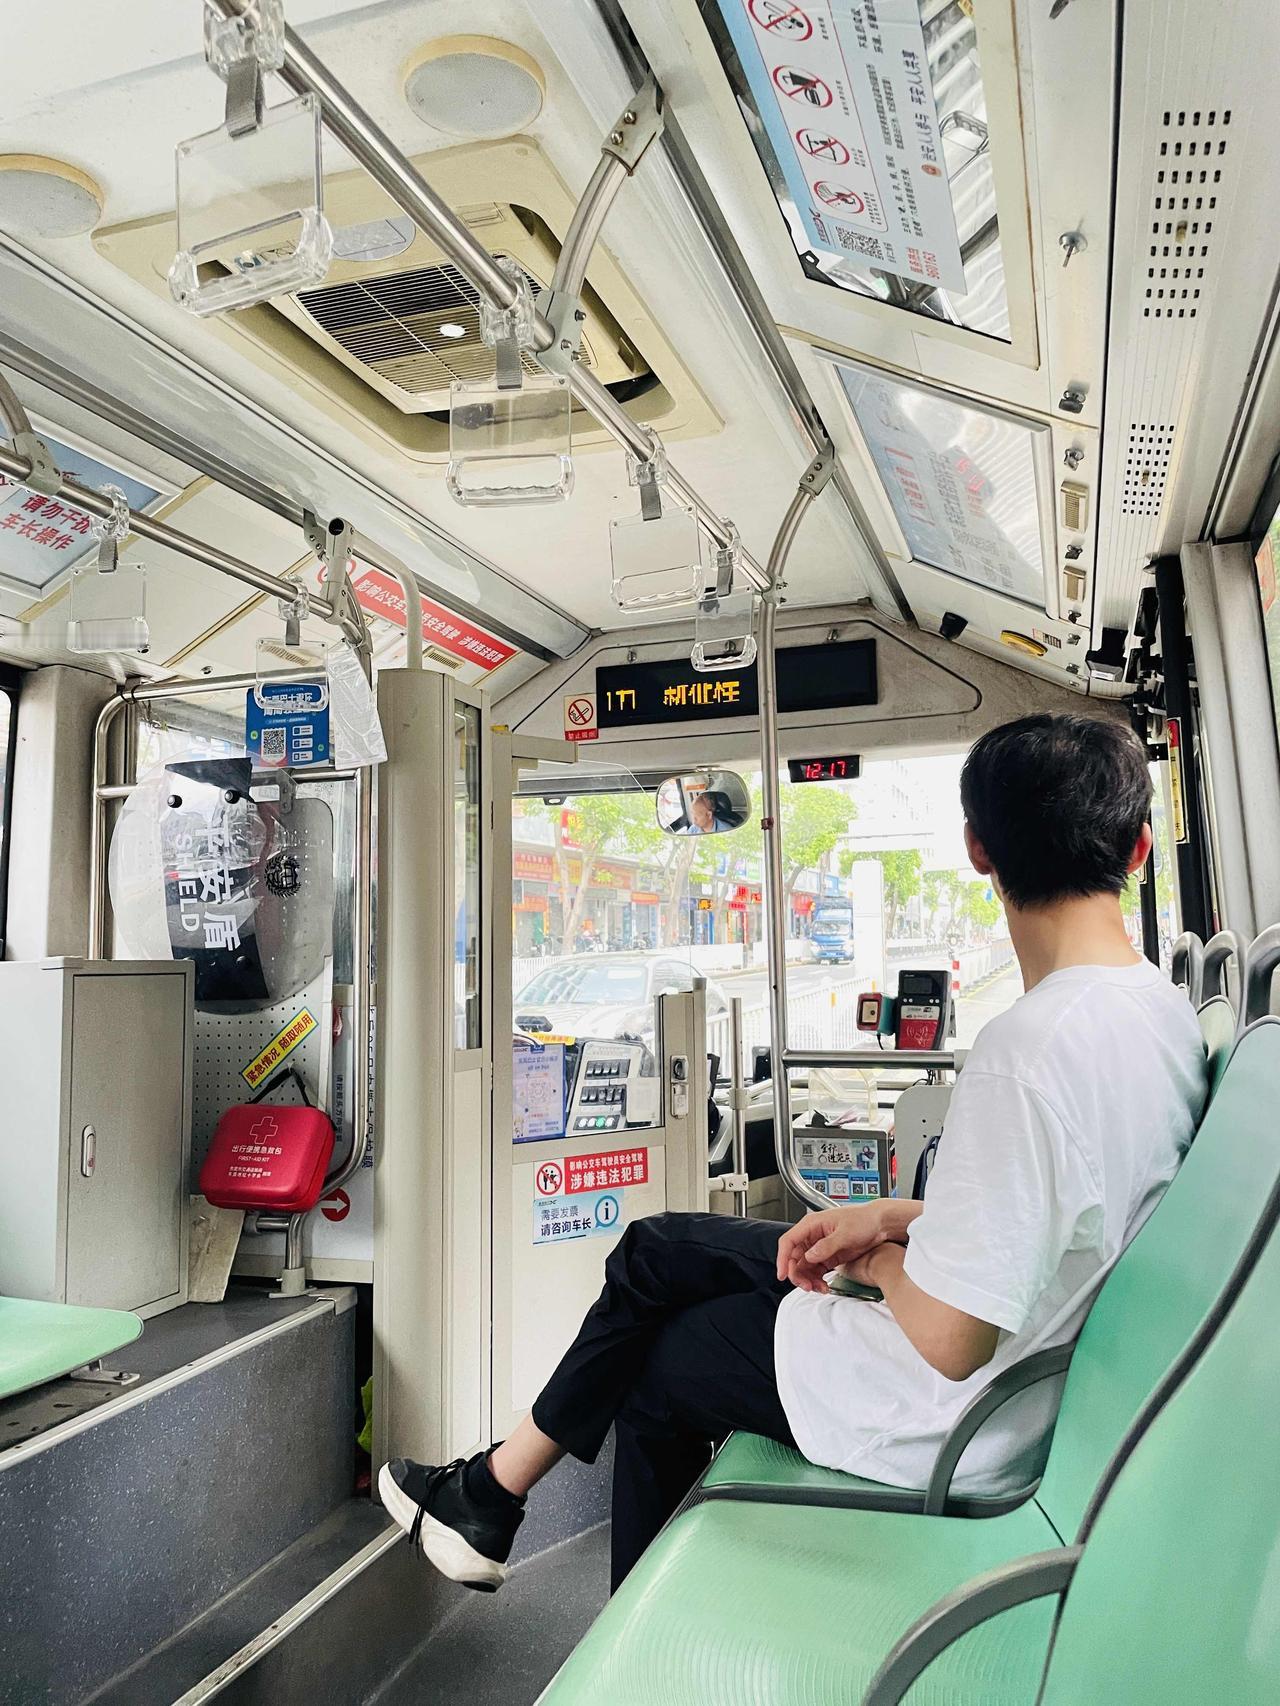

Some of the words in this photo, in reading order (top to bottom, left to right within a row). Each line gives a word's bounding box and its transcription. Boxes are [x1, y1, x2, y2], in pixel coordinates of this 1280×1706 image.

[0, 512, 75, 550] 车长操作
[21, 494, 92, 534] 请勿干扰
[355, 579, 461, 640] 影响公交车员安全驾驶
[196, 813, 240, 951] 平安盾
[246, 1048, 280, 1084] 紧急情况
[278, 1013, 313, 1051] 随取随用
[569, 1153, 643, 1171] 影响公交车驾驶员安全驾驶
[571, 1164, 644, 1190] 涉嫌违法犯罪
[541, 1205, 579, 1222] 需要发票
[541, 1217, 591, 1237] 请咨询车长
